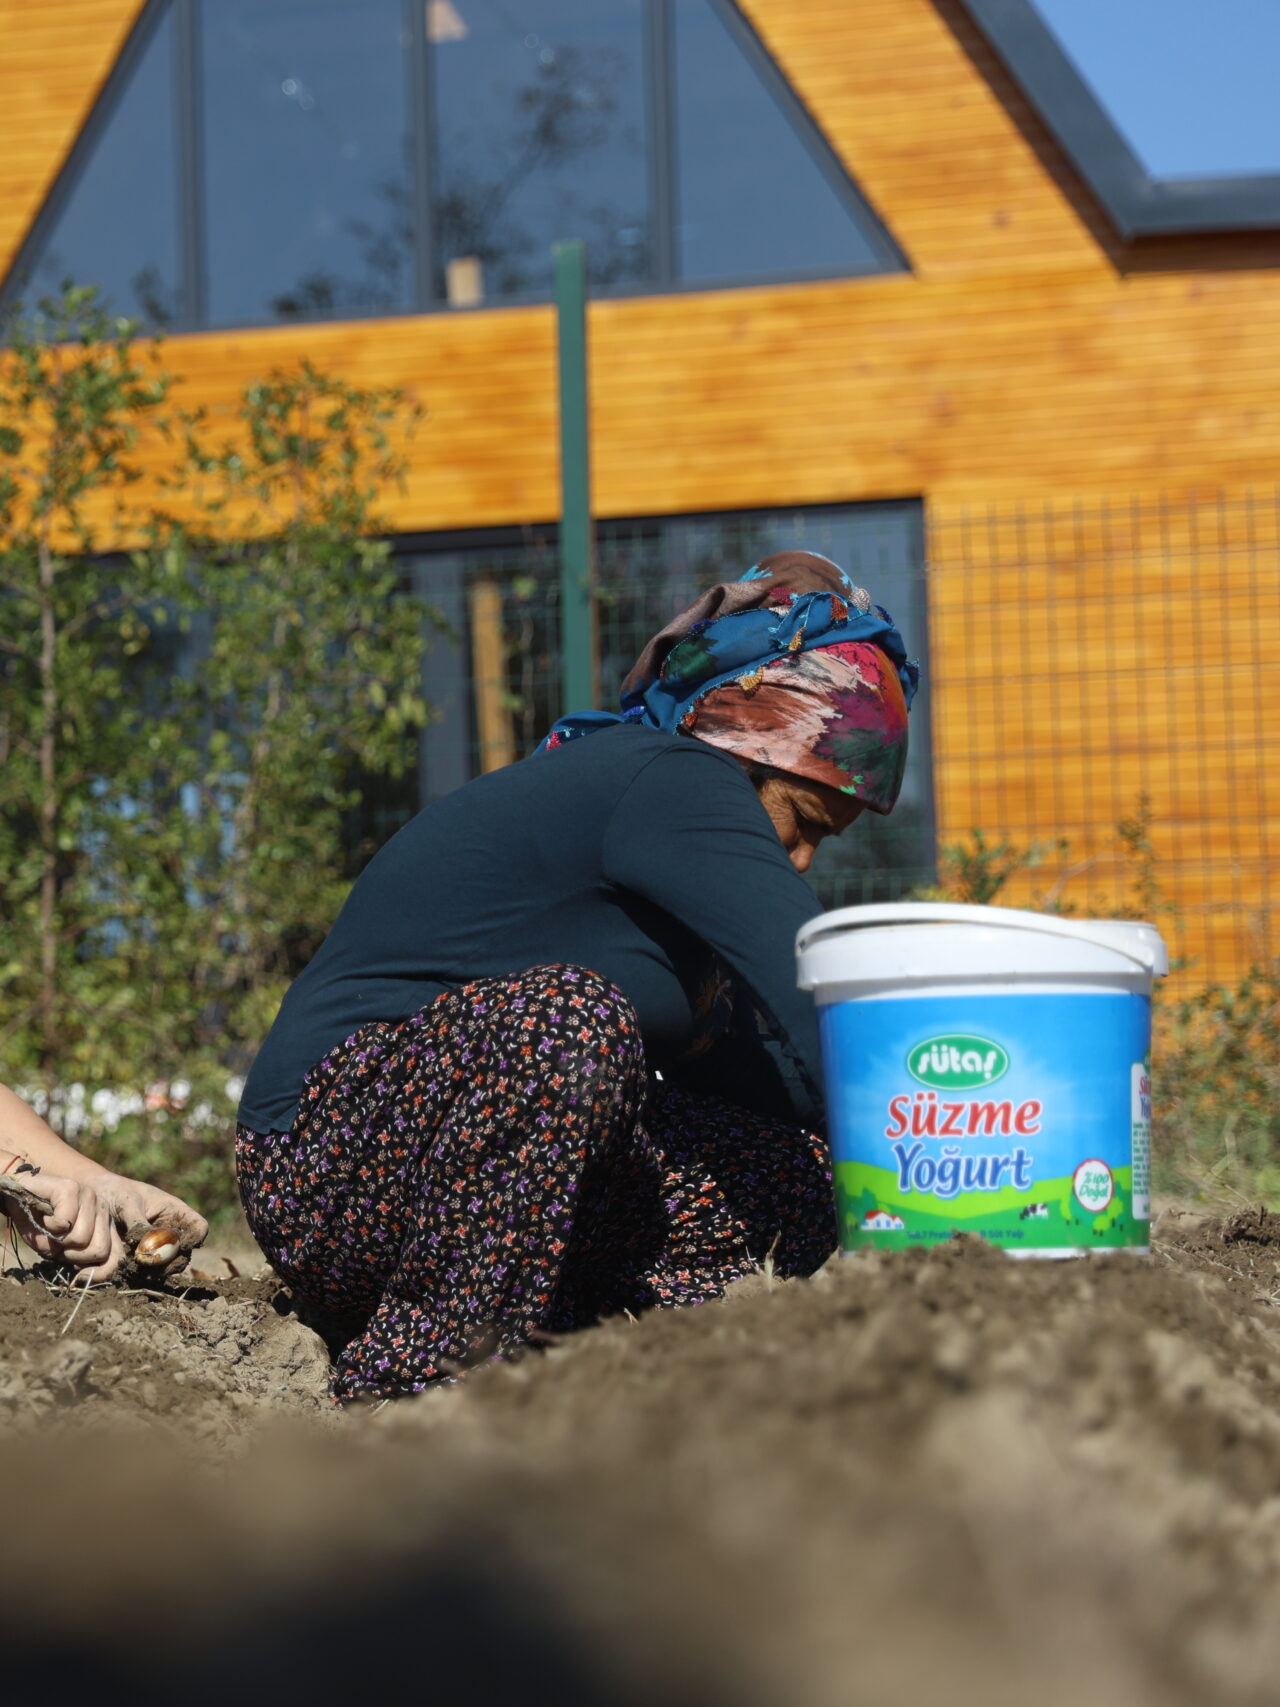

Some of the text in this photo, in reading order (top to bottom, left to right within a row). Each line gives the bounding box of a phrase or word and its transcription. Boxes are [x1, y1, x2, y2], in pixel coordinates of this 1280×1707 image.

[918, 1044, 997, 1081] sütaş
[885, 1092, 1041, 1139] Süzme
[893, 1142, 1032, 1196] Yoğurt
